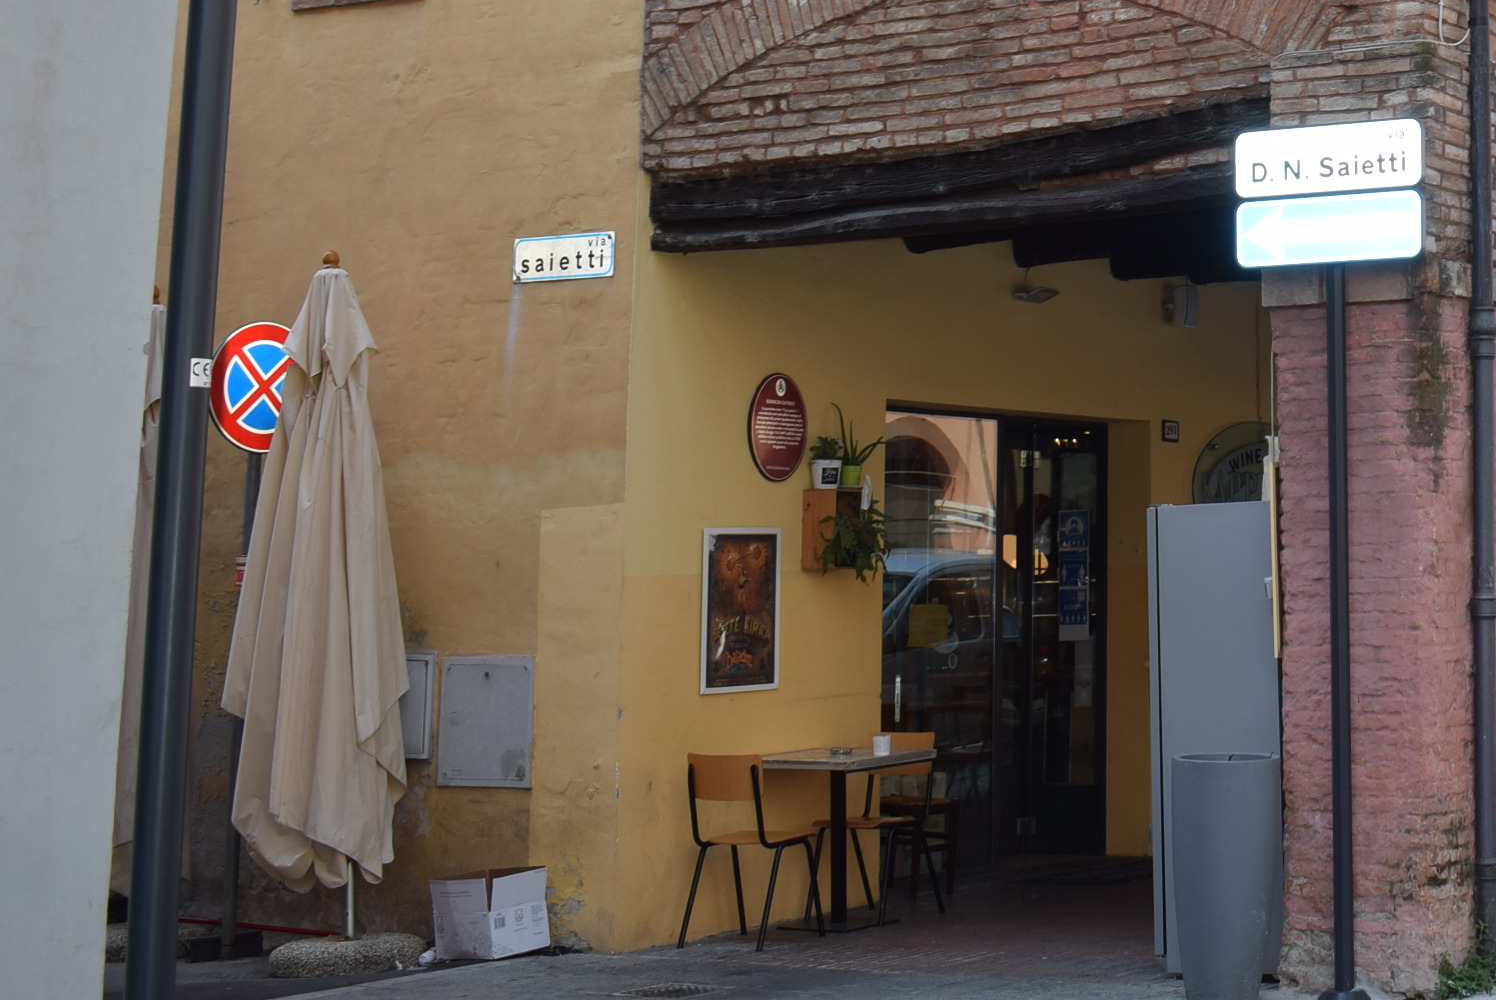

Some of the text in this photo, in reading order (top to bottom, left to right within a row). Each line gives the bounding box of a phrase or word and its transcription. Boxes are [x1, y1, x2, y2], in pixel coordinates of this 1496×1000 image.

[1387, 129, 1406, 140] via
[1251, 150, 1406, 183] D. N. Saietti
[588, 237, 606, 247] via
[520, 248, 604, 274] saietti
[1228, 448, 1262, 473] WINE
